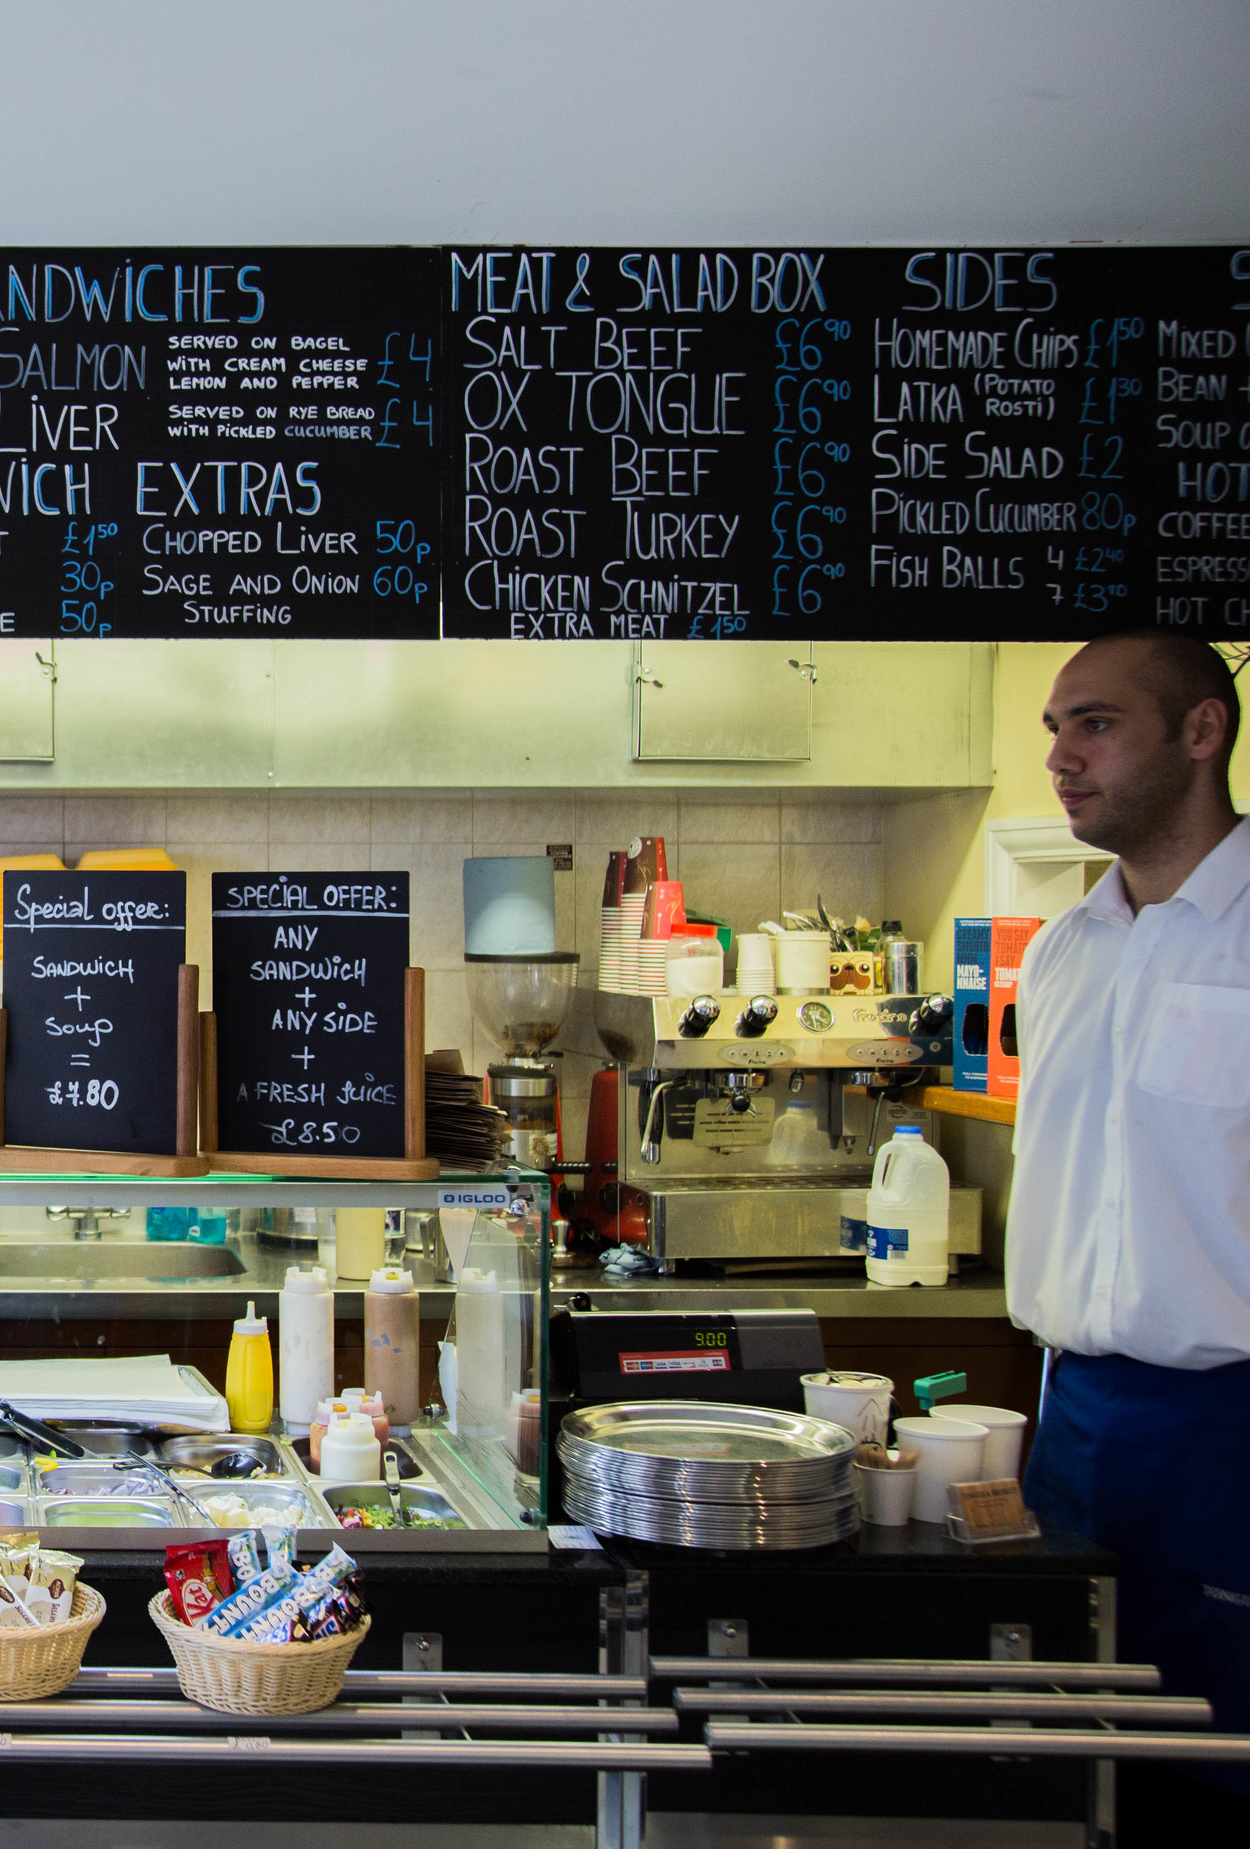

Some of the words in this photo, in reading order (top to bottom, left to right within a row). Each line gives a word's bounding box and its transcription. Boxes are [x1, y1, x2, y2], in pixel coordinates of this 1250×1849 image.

[566, 253, 594, 312] &
[169, 335, 238, 349] SERVED
[251, 337, 277, 349] ON
[291, 336, 350, 351] BAGEL
[224, 357, 286, 372] CREAM
[299, 359, 368, 372] CHEESE
[170, 376, 226, 389] LEMON
[240, 376, 277, 389] AND
[292, 375, 359, 389] PEPPER
[169, 405, 244, 419] SERVED
[256, 406, 277, 418] ON
[290, 406, 317, 419] RYE
[327, 406, 375, 419] BREAD
[285, 425, 372, 440] CUCUMBER
[229, 574, 281, 595] AND
[510, 614, 594, 638] EXTRA
[610, 614, 668, 639] MEAT
[14, 884, 94, 933] Special
[274, 925, 318, 951] ANY
[272, 1009, 317, 1034] ANY
[258, 1082, 325, 1106] FRESH
[458, 1194, 506, 1203] IGLOO
